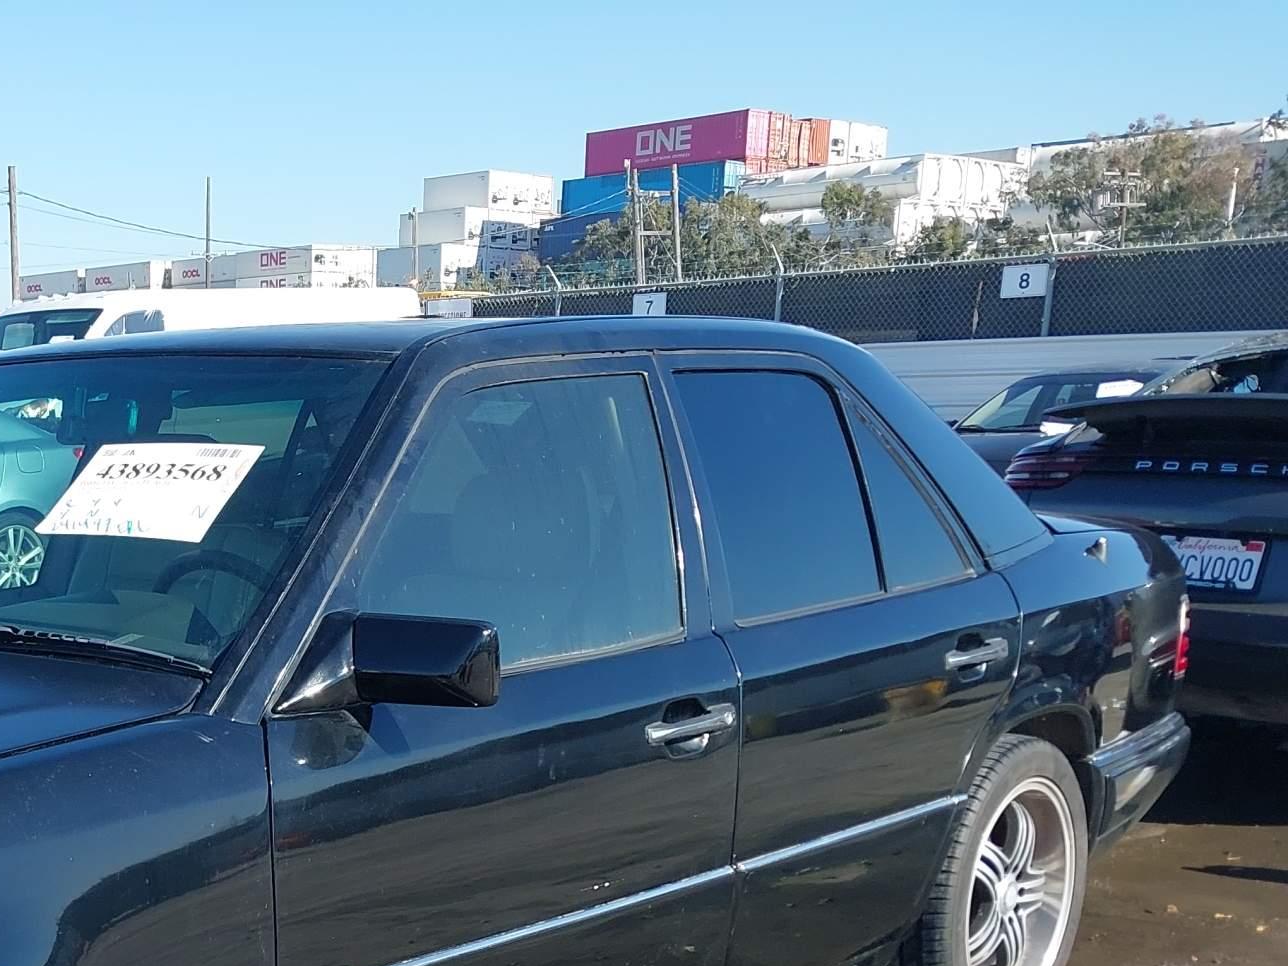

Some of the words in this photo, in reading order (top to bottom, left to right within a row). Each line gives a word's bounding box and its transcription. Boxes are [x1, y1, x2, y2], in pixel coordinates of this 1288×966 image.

[636, 125, 692, 156] ONE
[260, 251, 286, 267] ONE
[1018, 272, 1030, 289] 8
[645, 300, 654, 315] 7
[96, 463, 228, 481] 43893568
[1180, 554, 1255, 582] CV000
